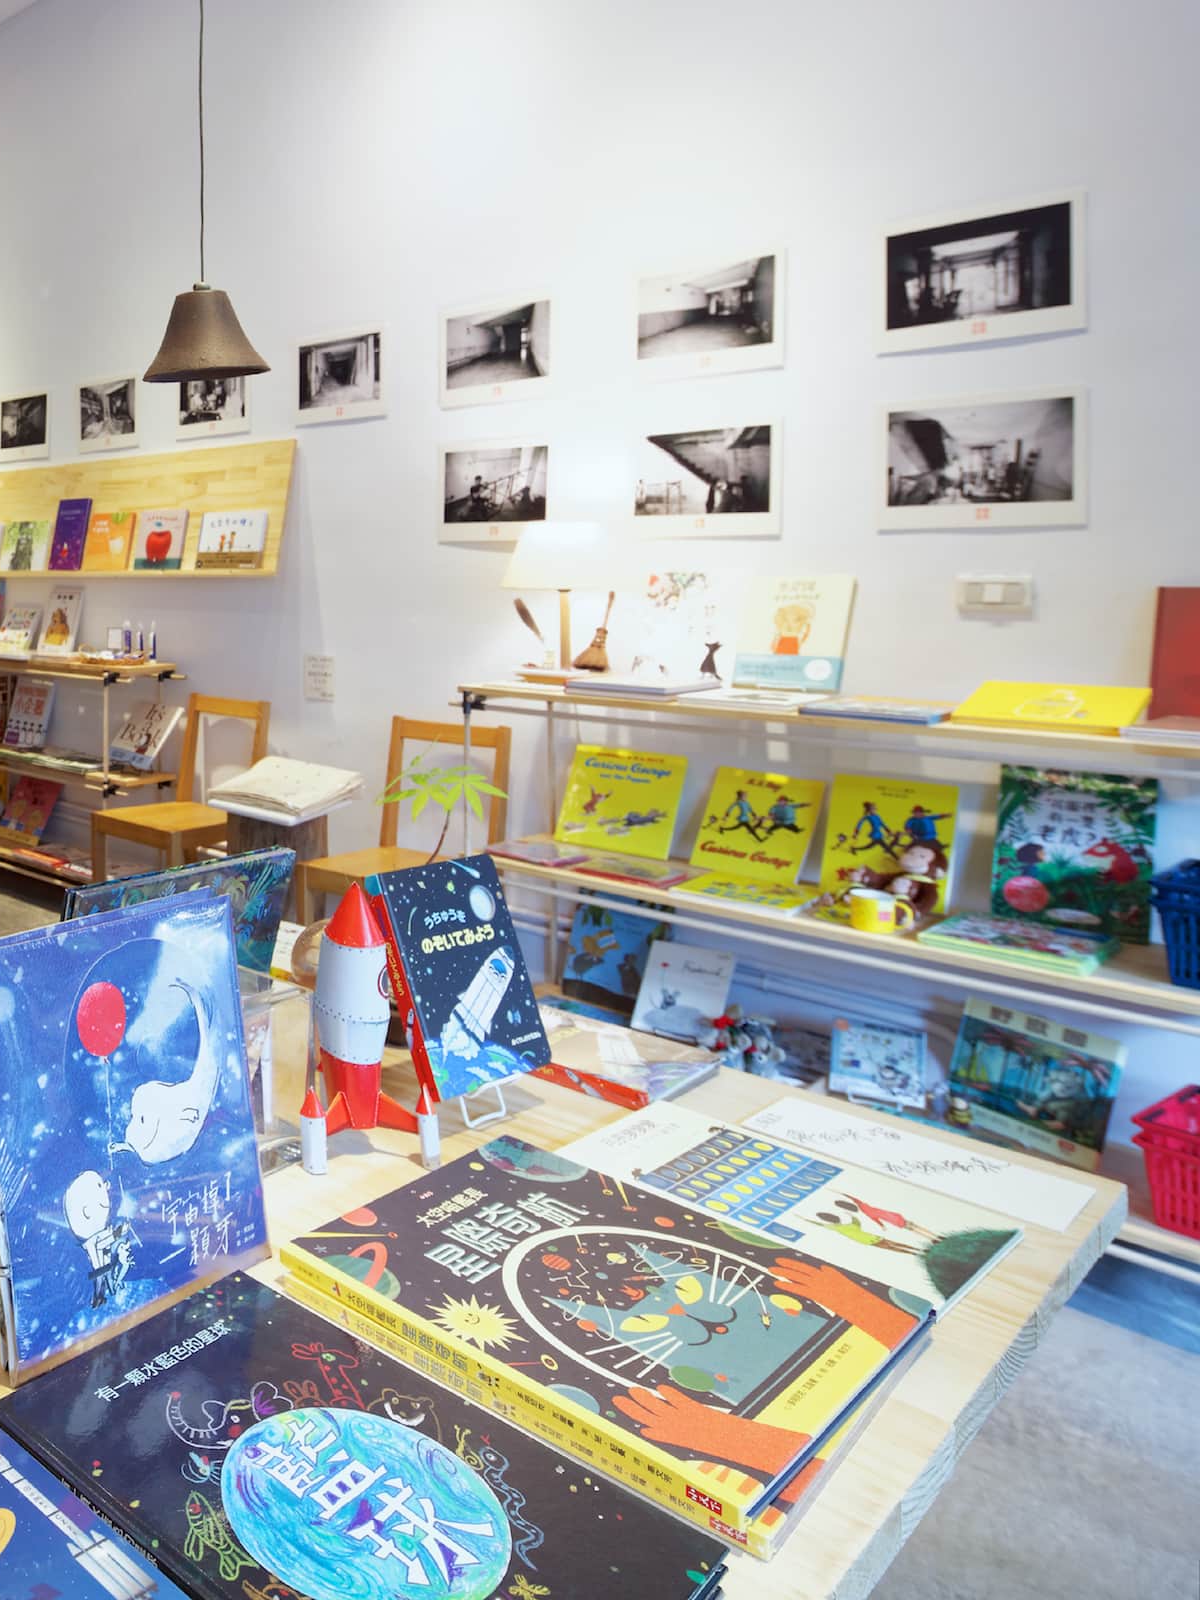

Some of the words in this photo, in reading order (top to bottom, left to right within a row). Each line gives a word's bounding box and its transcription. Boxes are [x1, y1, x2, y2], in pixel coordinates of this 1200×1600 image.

[700, 840, 748, 859] Curious
[749, 849, 792, 868] George
[423, 908, 467, 930] うちゅうを
[421, 924, 495, 955] のぞいてみよう
[424, 1191, 590, 1284] 星際奇航
[94, 1319, 231, 1402] 有一顆水藍色的星球
